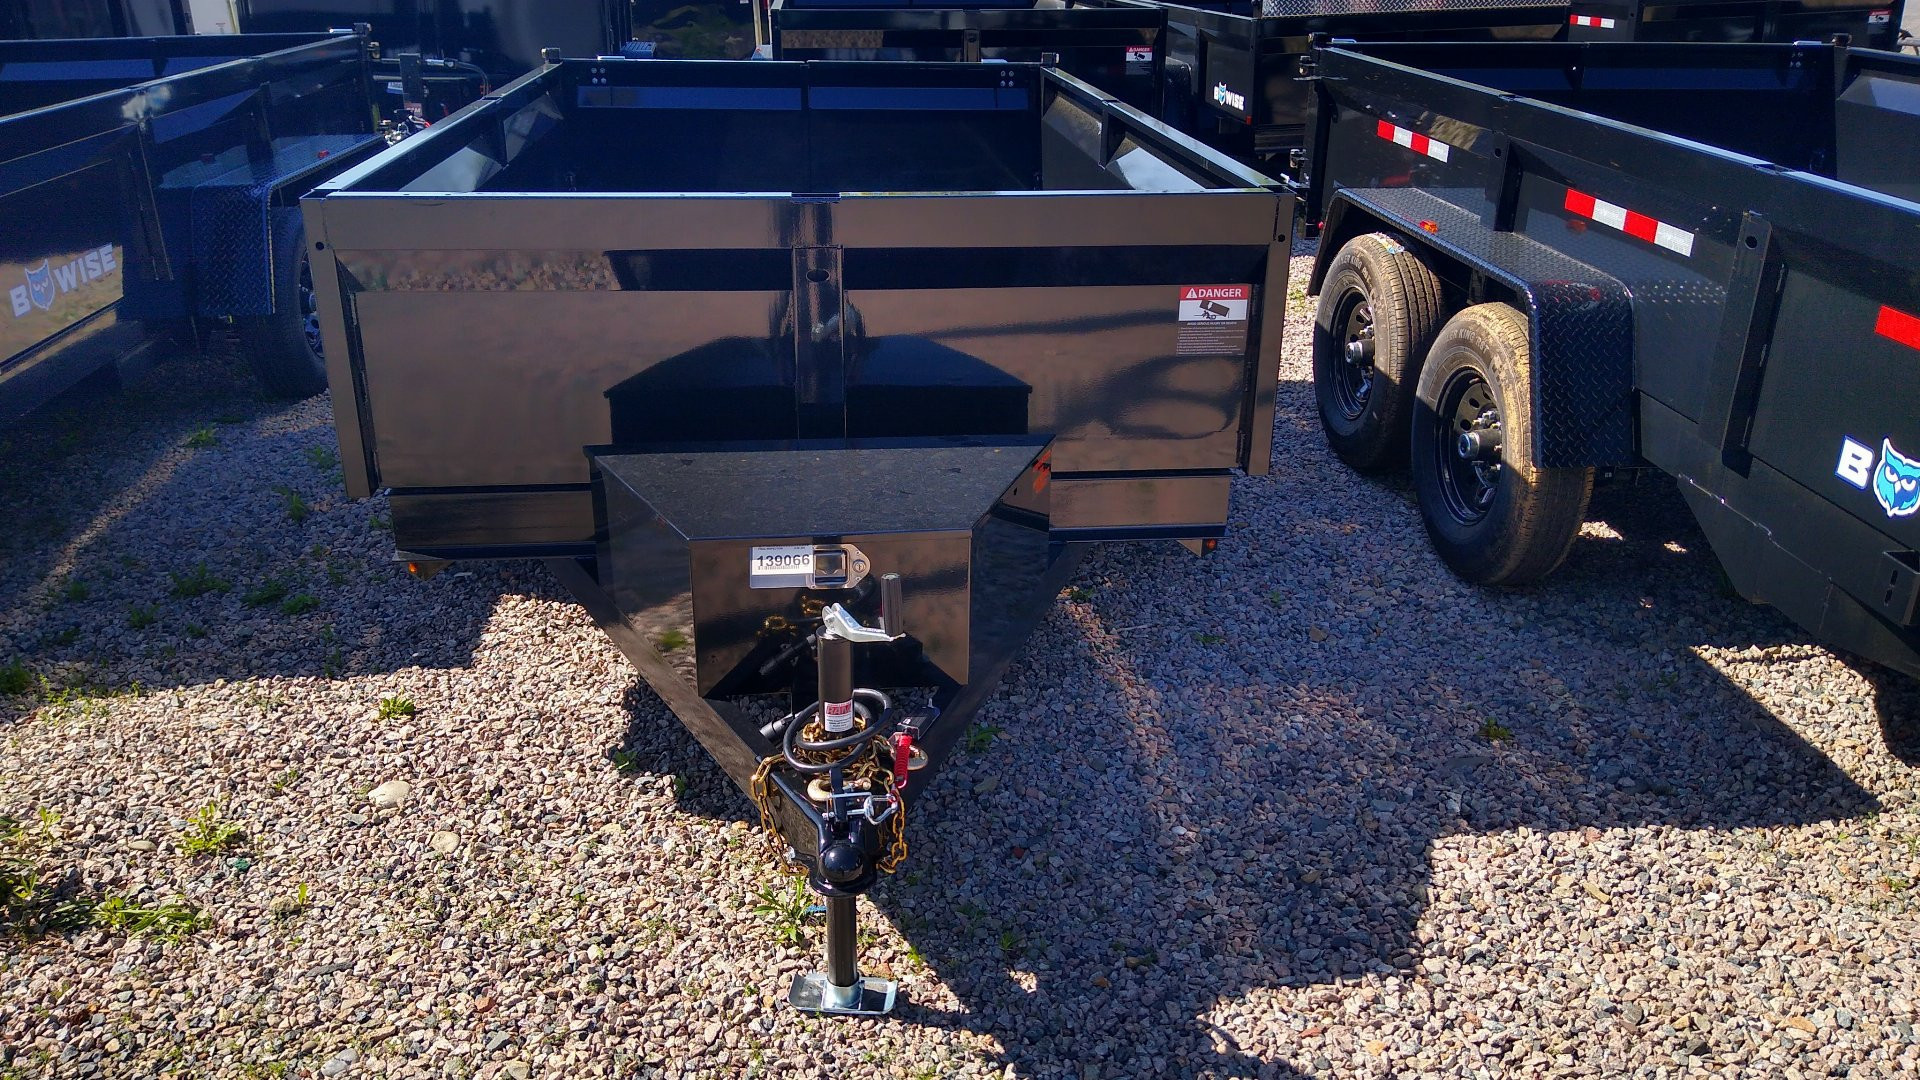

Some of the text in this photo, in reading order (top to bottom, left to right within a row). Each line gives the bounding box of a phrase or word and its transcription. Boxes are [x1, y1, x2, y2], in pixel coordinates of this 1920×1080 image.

[1198, 288, 1242, 298] DANGER
[1458, 328, 1476, 341] KING
[757, 554, 810, 567] 139066
